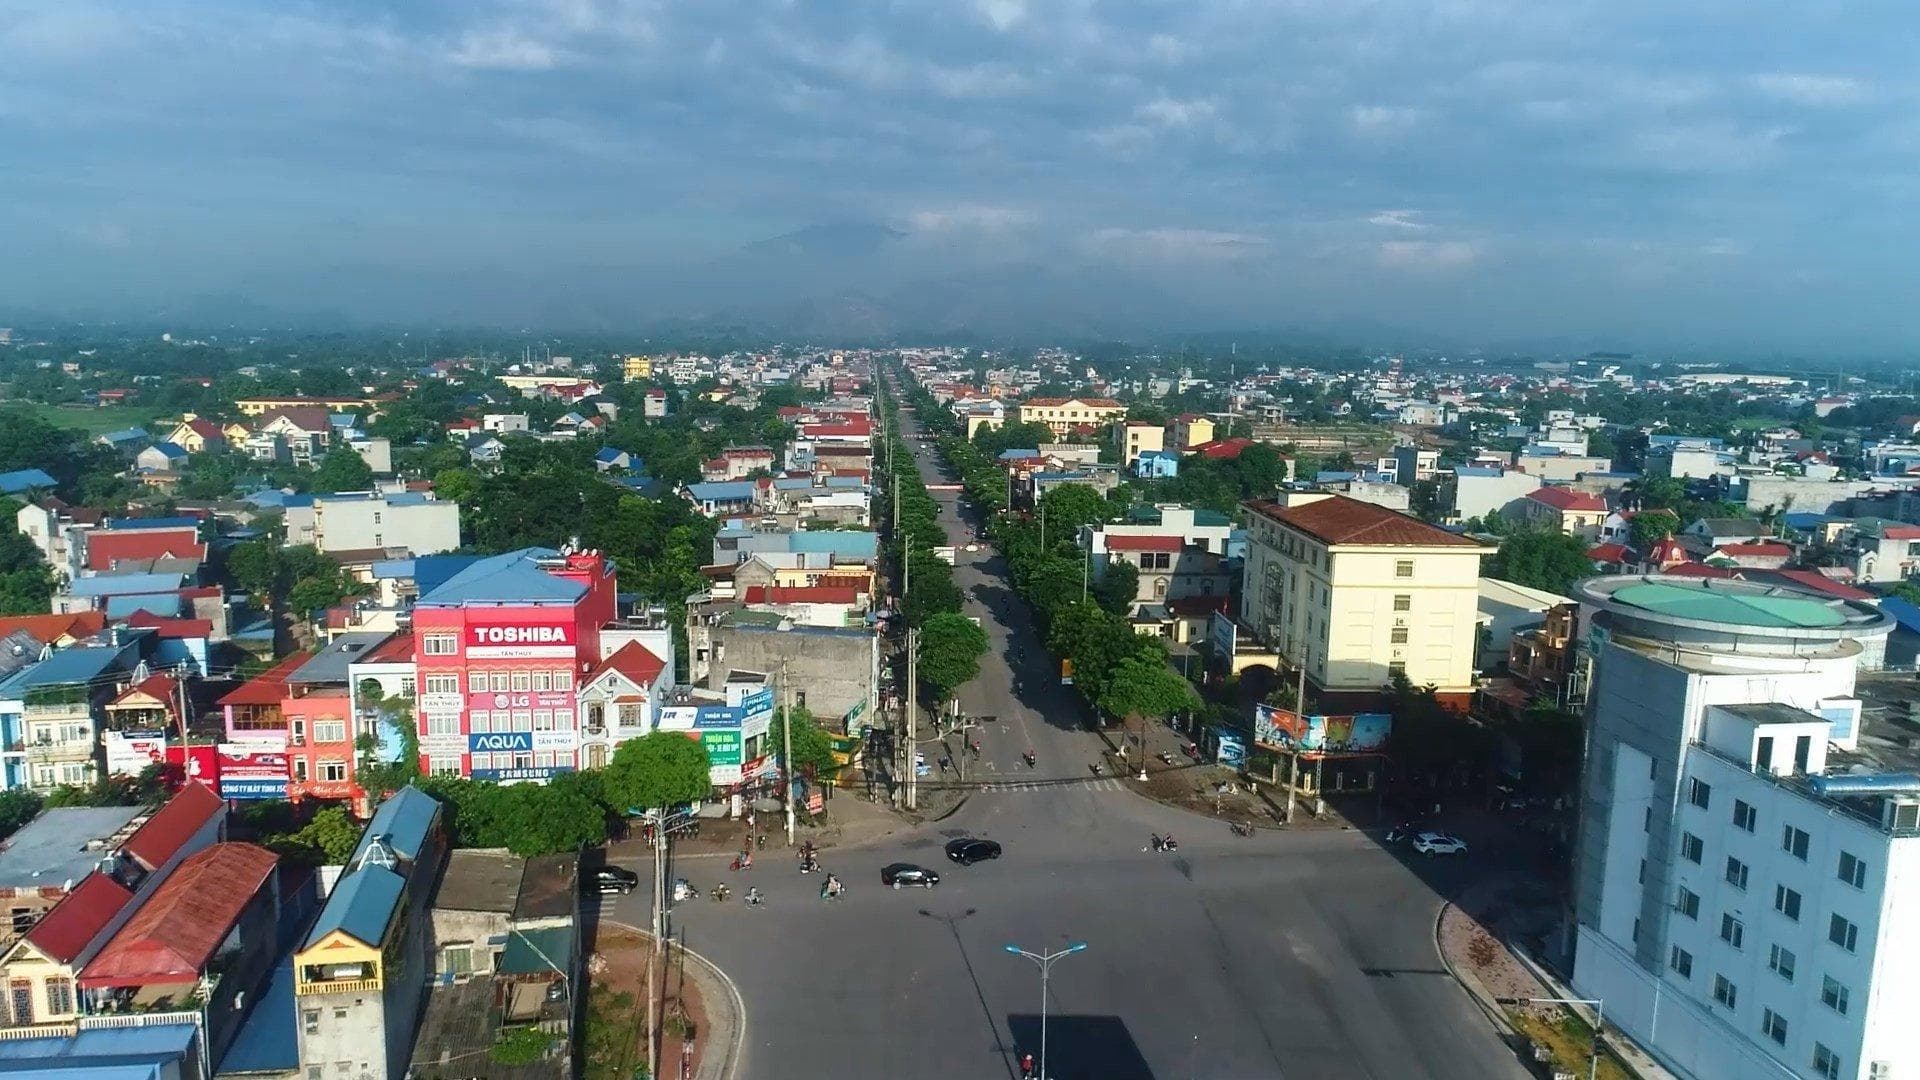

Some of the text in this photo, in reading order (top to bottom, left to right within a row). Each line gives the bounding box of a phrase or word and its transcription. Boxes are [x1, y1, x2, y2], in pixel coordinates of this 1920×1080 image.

[474, 626, 567, 643] TOSHIBA
[511, 695, 530, 706] LG
[476, 736, 528, 750] AQUA
[498, 768, 549, 779] SAMSUNG
[221, 782, 238, 793] CÔNG
[239, 784, 246, 793] TY
[247, 782, 261, 793] MÁY
[261, 782, 276, 793] TÍNH
